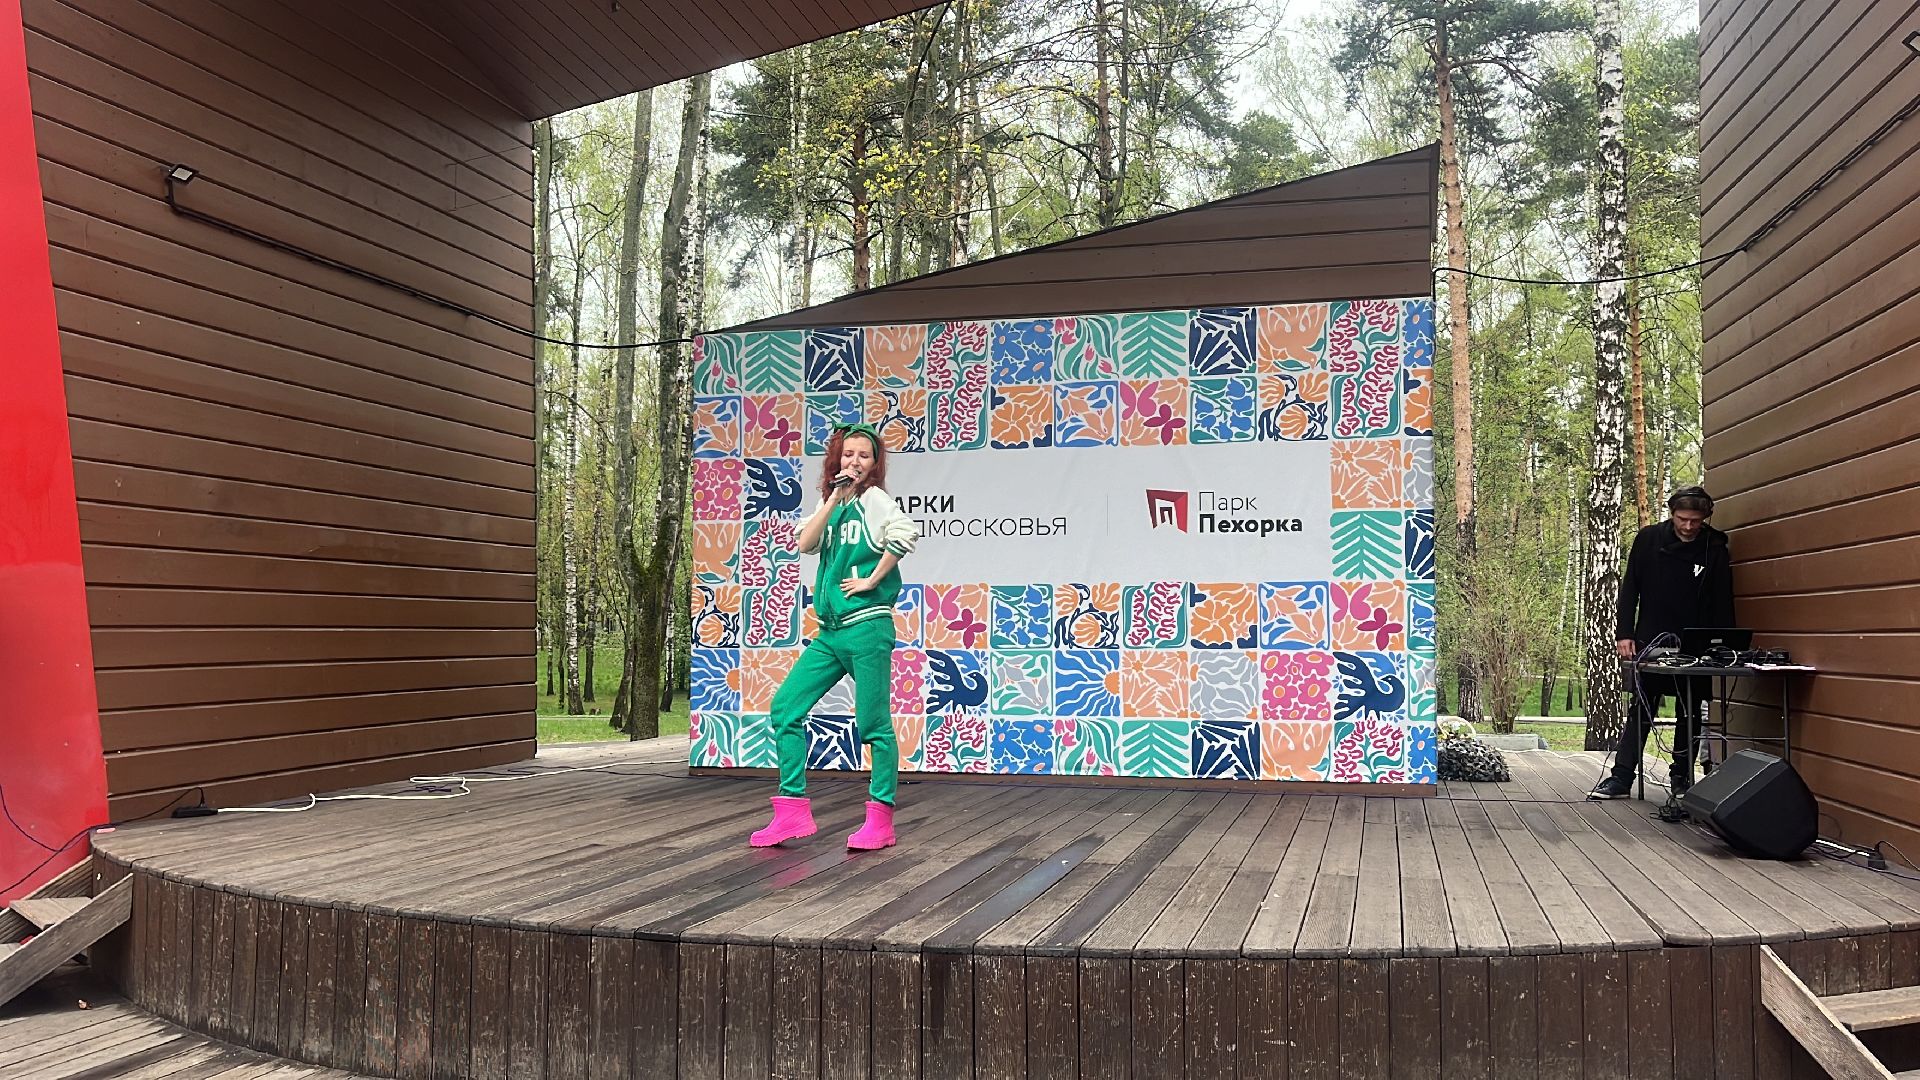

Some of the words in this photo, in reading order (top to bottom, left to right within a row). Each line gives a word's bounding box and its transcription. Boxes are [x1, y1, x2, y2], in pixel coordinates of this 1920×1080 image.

[894, 495, 954, 514] АРКИ
[1199, 491, 1258, 516] Парк
[913, 517, 1067, 538] ДМОСКОВЬЯ
[1199, 513, 1303, 538] Пехорка
